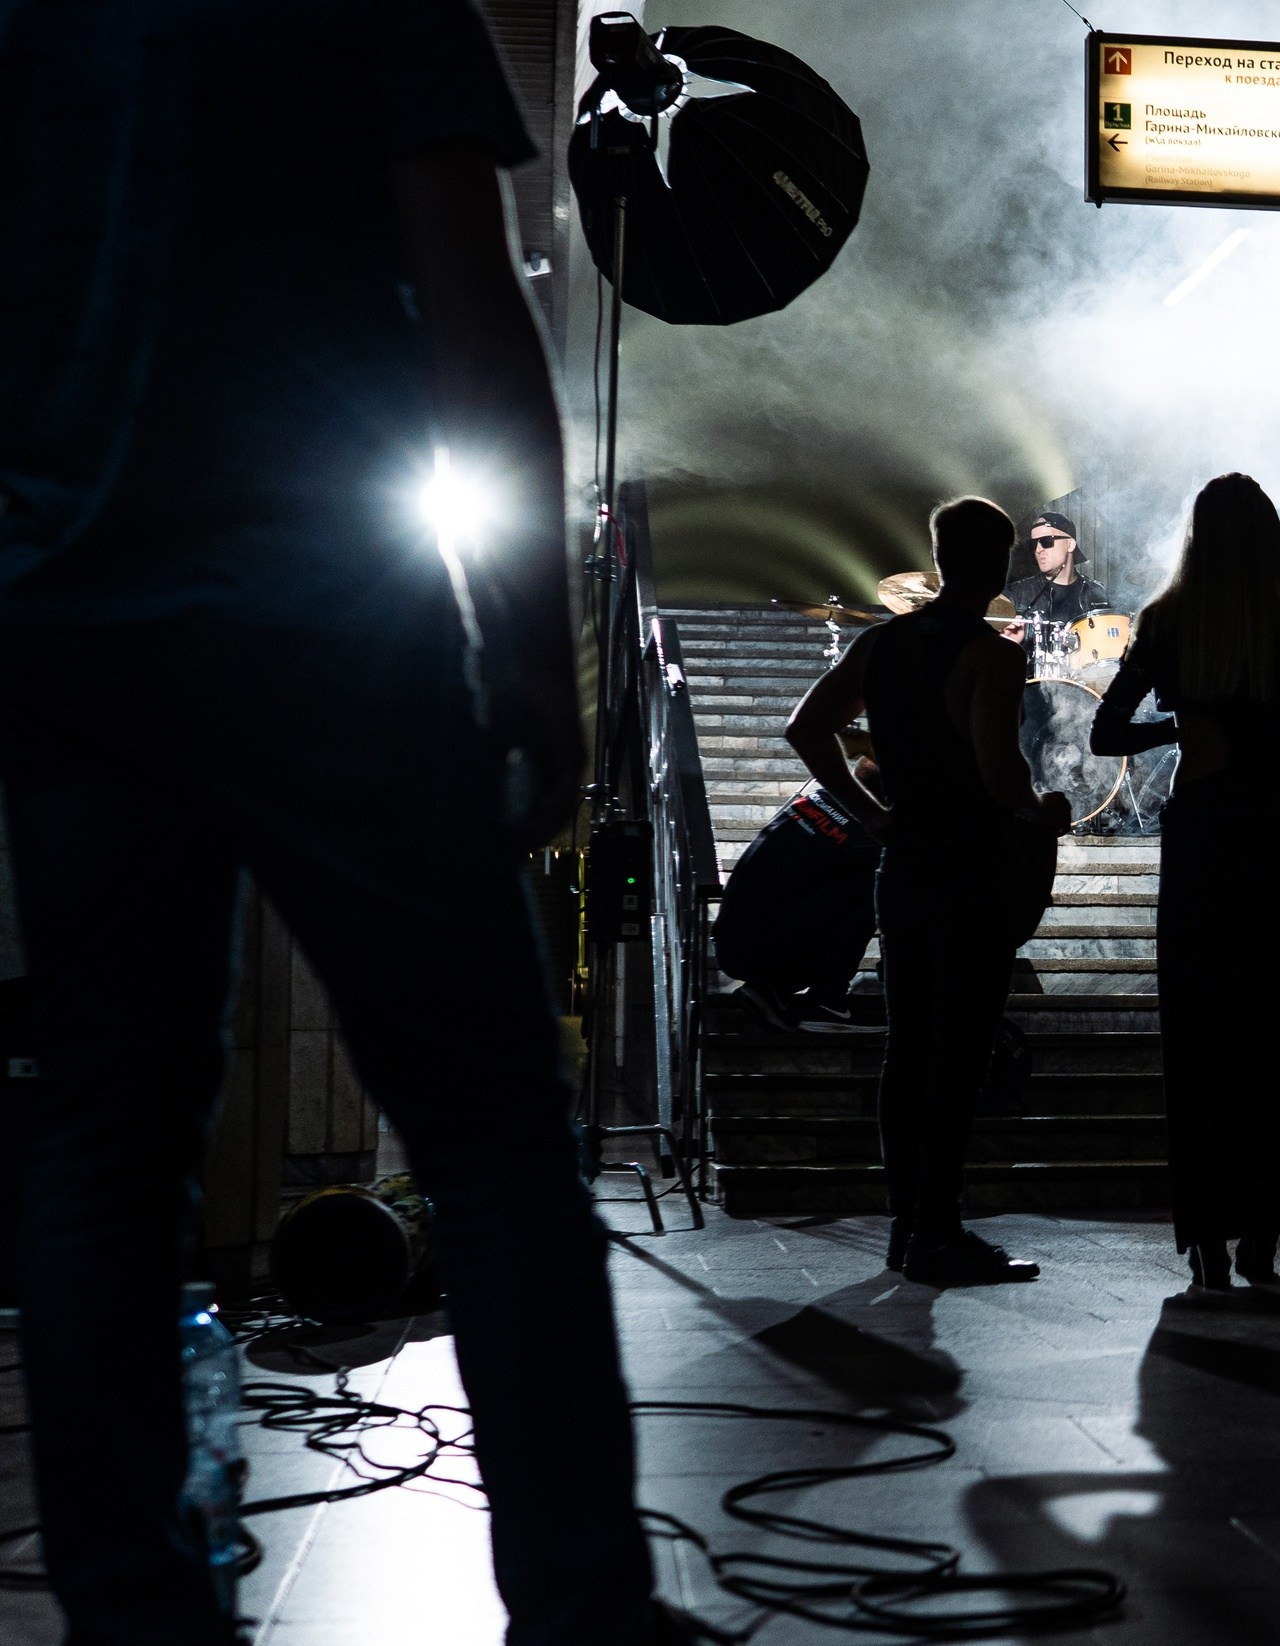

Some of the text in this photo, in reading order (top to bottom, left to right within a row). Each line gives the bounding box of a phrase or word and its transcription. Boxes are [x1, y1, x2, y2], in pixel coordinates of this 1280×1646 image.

[1164, 51, 1232, 69] Переход
[1237, 58, 1255, 69] на
[1225, 74, 1232, 83] к
[1112, 104, 1124, 122] 1
[1145, 104, 1207, 119] Площадь
[1144, 176, 1213, 187] (Railway Station)
